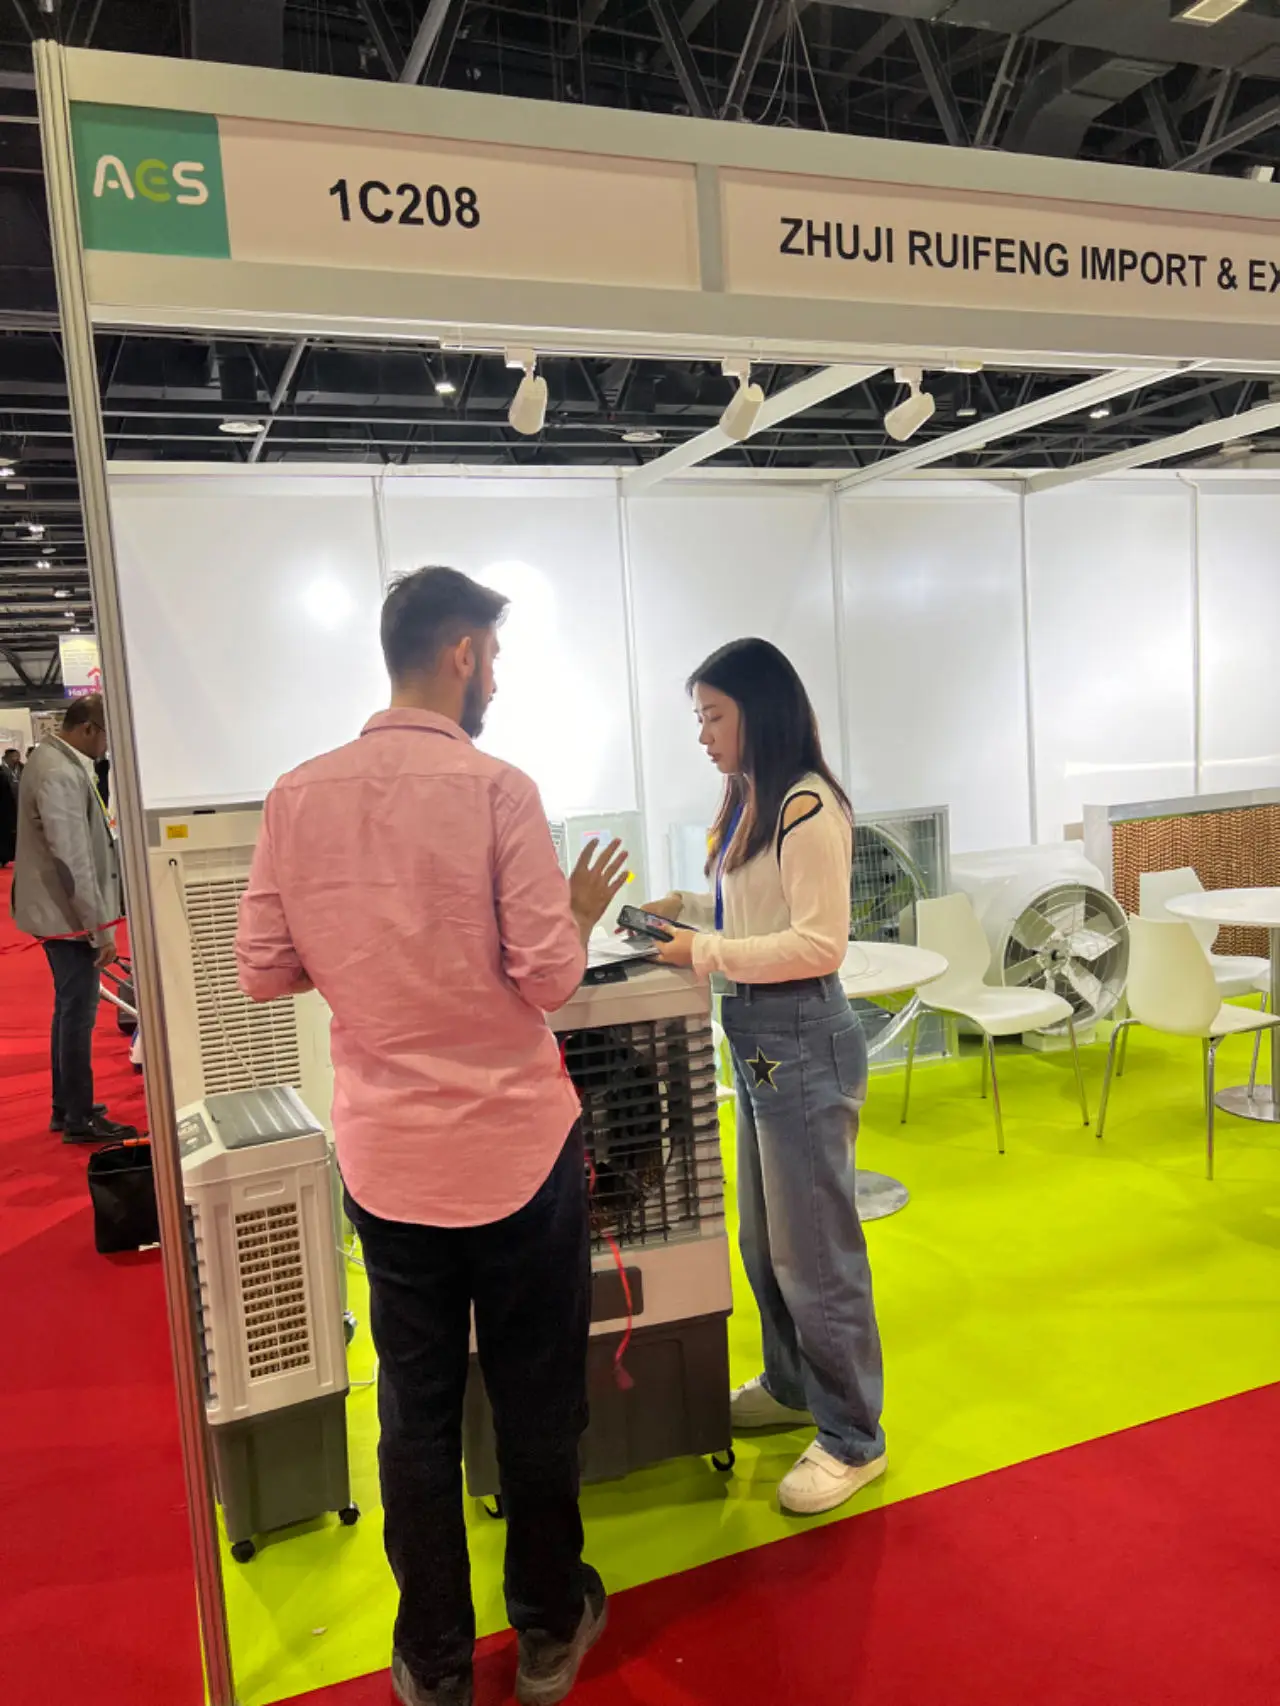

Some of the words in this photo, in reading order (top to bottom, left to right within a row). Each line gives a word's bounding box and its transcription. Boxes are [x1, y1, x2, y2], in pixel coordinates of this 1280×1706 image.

[92, 154, 209, 206] AES
[329, 178, 480, 229] 1C208
[779, 217, 894, 263] ZHUJI
[908, 230, 1069, 277] RUIFENG
[1081, 245, 1208, 287] IMPORT
[1217, 257, 1238, 290] &
